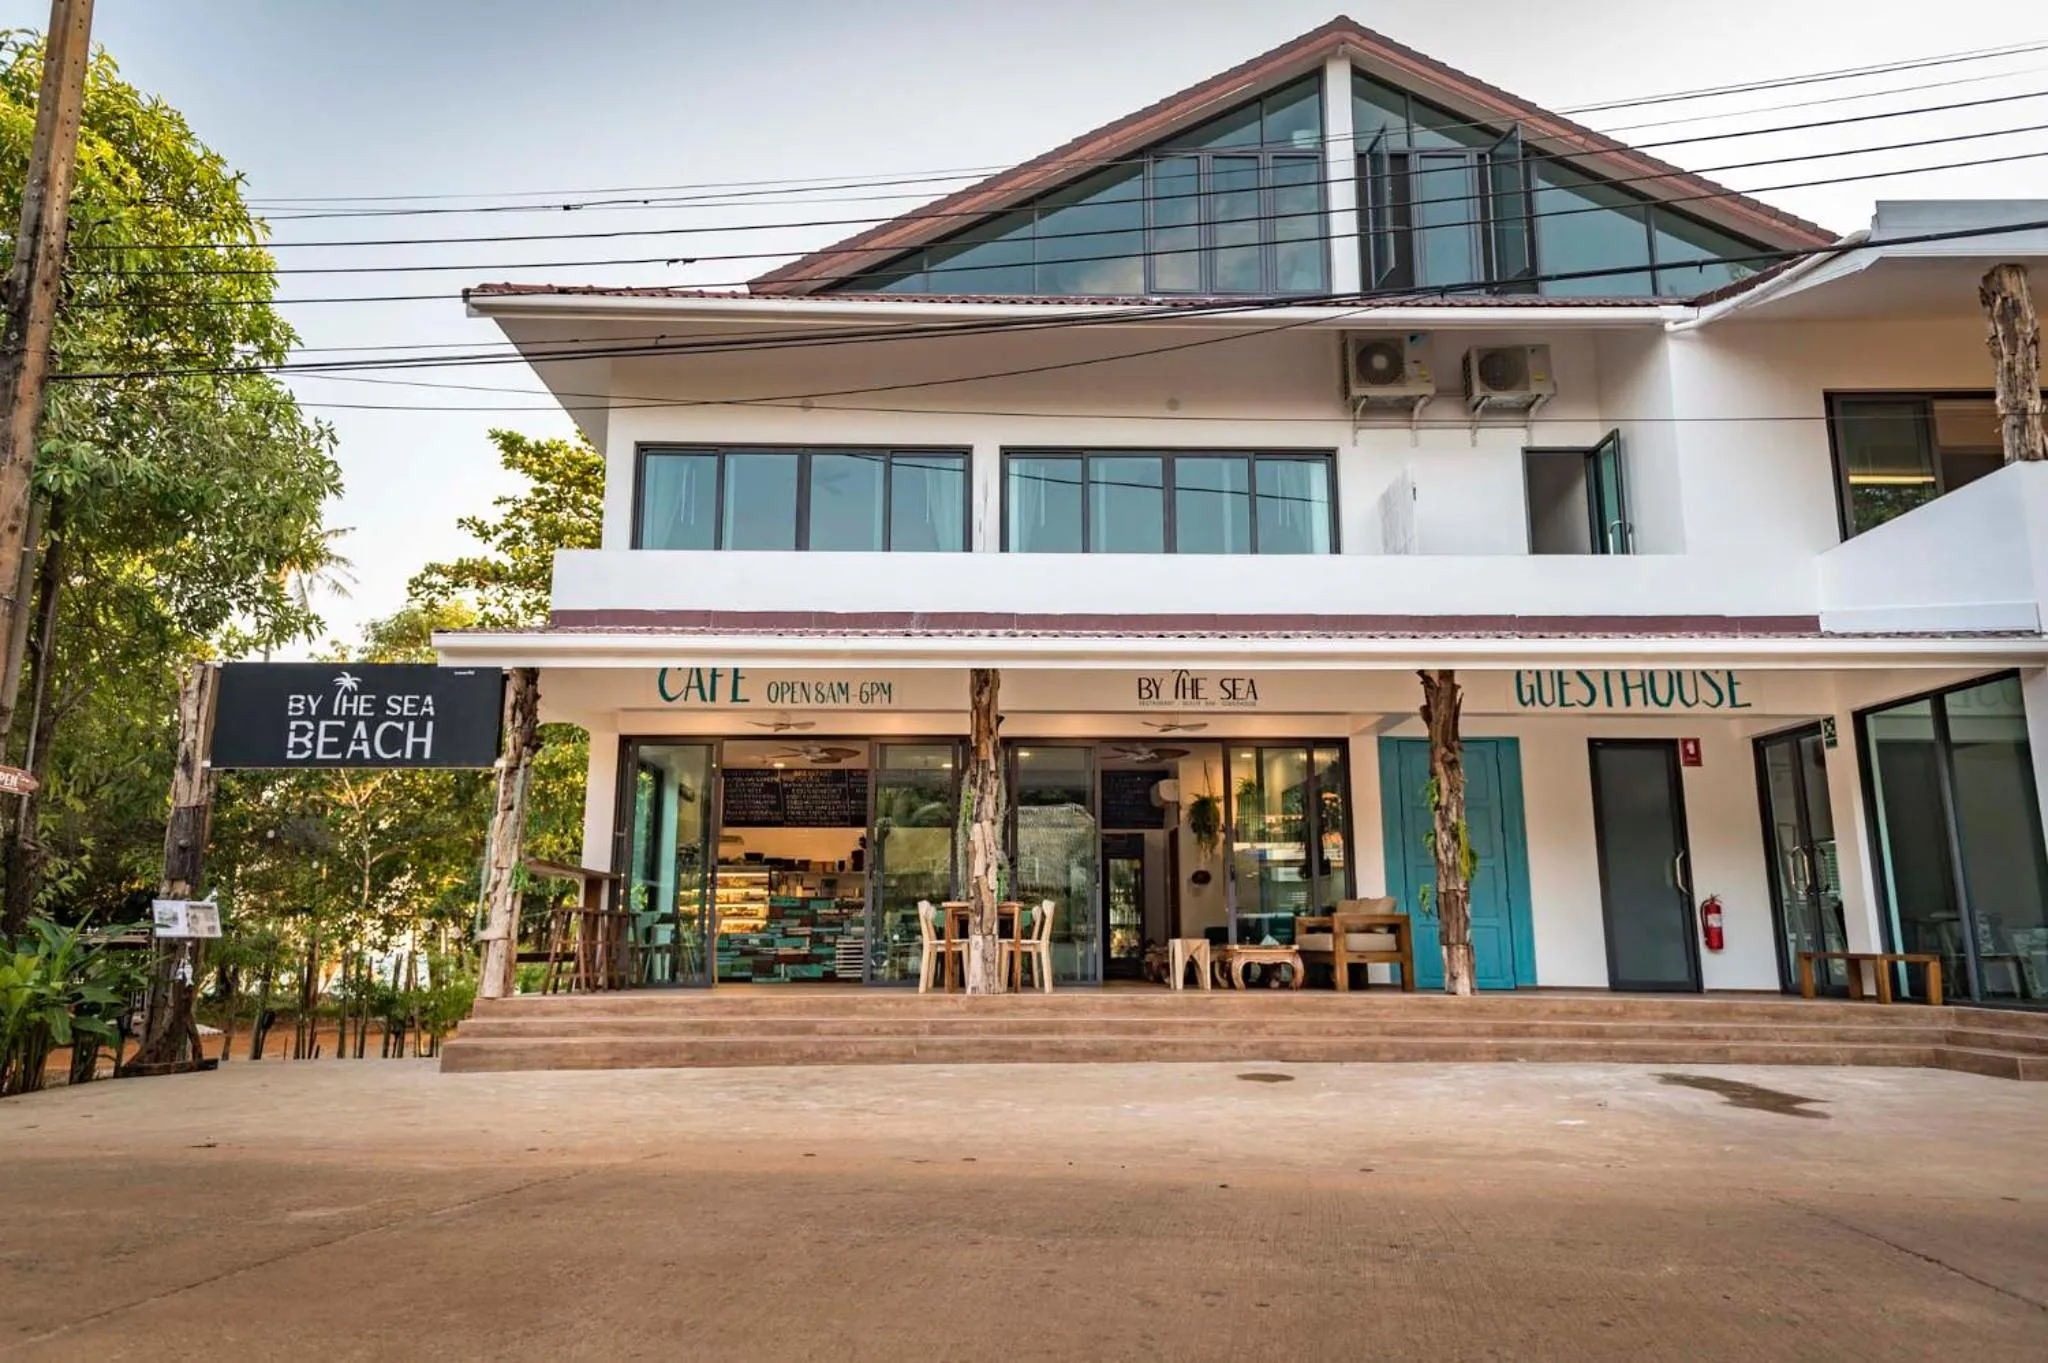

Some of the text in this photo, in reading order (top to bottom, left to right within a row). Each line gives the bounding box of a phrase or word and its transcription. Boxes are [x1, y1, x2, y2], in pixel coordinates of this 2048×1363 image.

[287, 672, 435, 716] BY THE SEA
[766, 681, 811, 705] OPEN
[1138, 669, 1258, 701] BY THE SEA
[1515, 669, 1752, 708] GUESTHOUSE
[286, 720, 435, 760] BEACH
